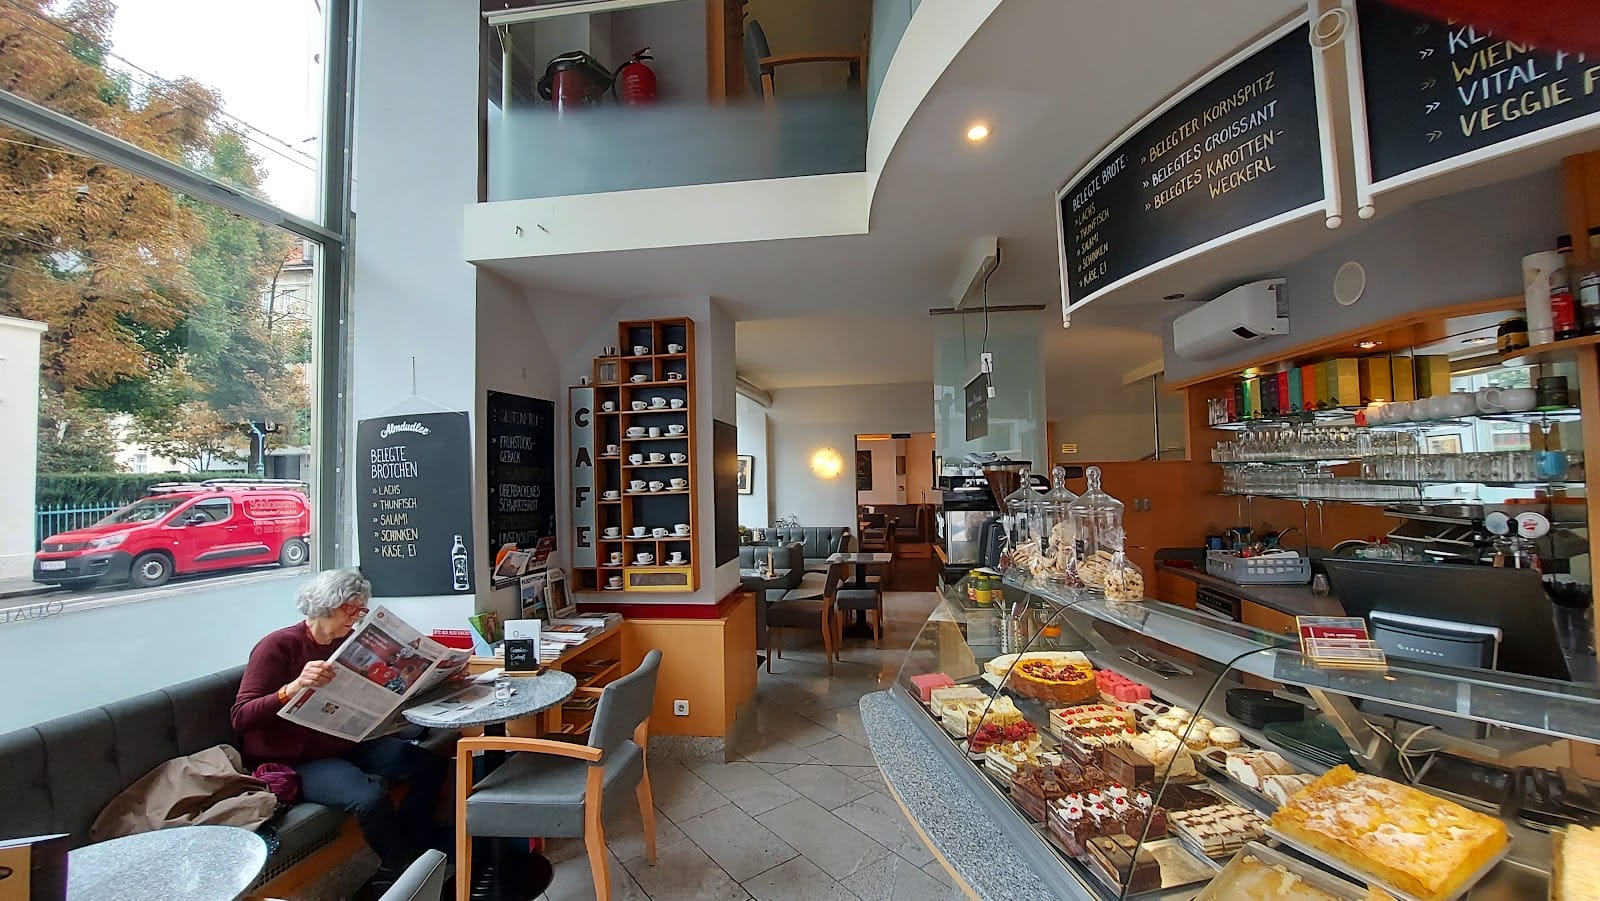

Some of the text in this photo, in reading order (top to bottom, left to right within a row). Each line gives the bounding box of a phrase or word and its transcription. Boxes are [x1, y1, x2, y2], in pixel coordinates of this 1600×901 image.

[1448, 24, 1493, 54] KL
[1452, 40, 1537, 83] WIEN
[1457, 58, 1548, 107] VITAL
[1149, 70, 1277, 163] BELEGTER KORNSPITZ
[1459, 77, 1573, 138] VEGGIE
[1151, 99, 1279, 188] BELEGTES CROISSANT
[1153, 168, 1203, 210] BELEGTES
[1208, 155, 1276, 200] WECKERL
[1072, 175, 1102, 213] BELEGTE
[1078, 201, 1096, 227] LACHS
[1079, 207, 1110, 241] THUNFISCH
[1081, 231, 1099, 256] SALAMI
[1082, 241, 1109, 270] SCHINKEN
[380, 420, 431, 439] Almdudler
[370, 445, 407, 463] BELEGTE
[371, 461, 418, 479] BRÖTCHEN
[574, 407, 593, 548] CAFE
[378, 484, 401, 496] LACHS
[379, 497, 418, 510] THUNFISCH
[380, 512, 408, 526] SALAMI
[380, 527, 419, 542] SCHINKEN
[381, 543, 417, 559] KÄSE, EI
